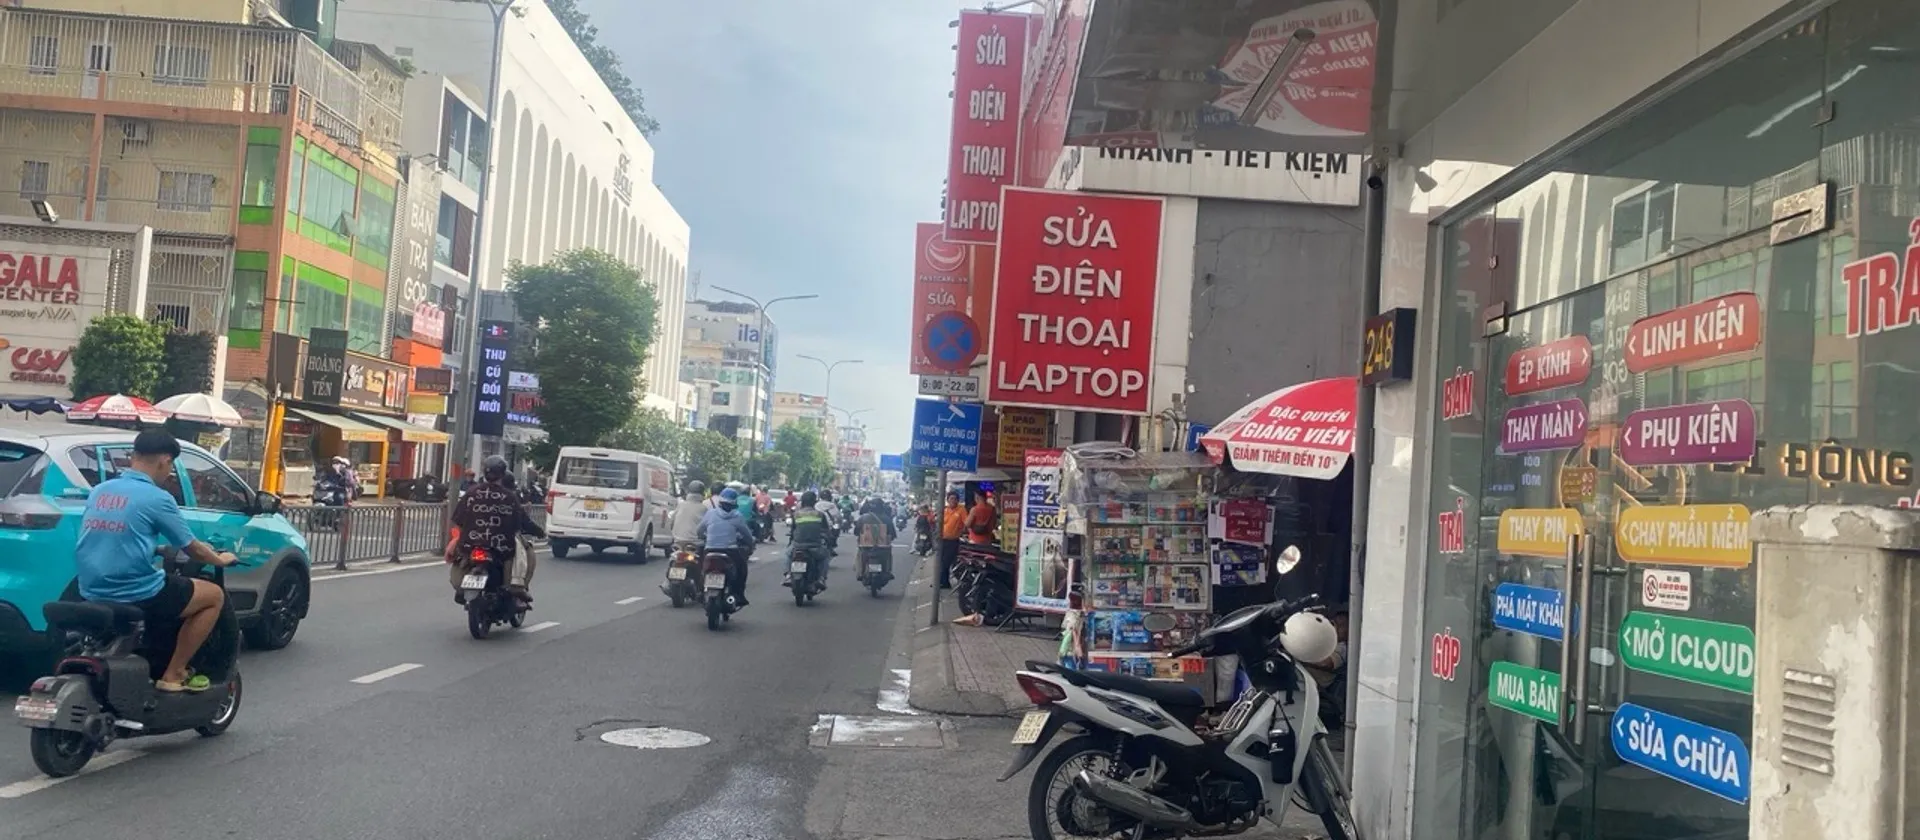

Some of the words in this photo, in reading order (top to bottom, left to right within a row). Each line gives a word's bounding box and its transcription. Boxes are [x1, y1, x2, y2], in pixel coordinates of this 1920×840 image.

[976, 24, 1007, 66] SỬA
[969, 84, 1006, 127] ĐIỆN
[962, 145, 1006, 183] THOẠI
[409, 201, 434, 237] BÁN
[950, 199, 999, 231] LAPTO
[1042, 206, 1118, 249] SỬA
[0, 252, 80, 292] GALA
[409, 238, 430, 277] TRẢ
[1032, 259, 1122, 304] ĐIỆN
[738, 323, 760, 342] ila
[1017, 313, 1131, 356] THOẠI
[1642, 319, 1687, 357] LINH
[1694, 299, 1746, 350] KIỆN
[11, 346, 73, 373] CGV
[308, 350, 342, 377] HOÀNG
[484, 348, 507, 361] THU
[1364, 321, 1394, 375] 248
[1518, 355, 1535, 384] ÉP
[1537, 348, 1571, 381] KÍNH
[311, 375, 333, 397] YẾN
[482, 379, 501, 395] ĐỔI
[485, 364, 501, 378] CŨ
[922, 381, 943, 391] 6:00
[950, 382, 976, 393] 22:00
[997, 360, 1144, 398] LAPTOP
[479, 399, 501, 413] MỚI
[1442, 366, 1474, 421] BÁN
[1240, 420, 1303, 441] GIẢNG
[1303, 425, 1352, 446] VIÊN
[1507, 415, 1539, 443] THAY
[1541, 403, 1575, 440] MÀN
[1641, 416, 1681, 456] PHỤ
[1687, 403, 1738, 454] KIỆN
[1232, 444, 1260, 463] GIẢM
[1262, 445, 1291, 465] THÊM
[1293, 449, 1317, 468] ĐẾN
[1781, 436, 1915, 488] ĐỘNG
[1030, 469, 1055, 482] iPhon
[1438, 496, 1464, 553] TRẢ
[1508, 515, 1540, 542] THAY
[1543, 515, 1567, 542] PIN
[1628, 520, 1665, 556] CHẠY
[1496, 591, 1515, 619] PHÁ
[1517, 594, 1537, 628] MẬT
[1432, 626, 1460, 681] GÓP
[1632, 618, 1665, 661] MỞ
[1671, 631, 1753, 677] ICLOUD
[1497, 671, 1525, 705] MUA
[1529, 675, 1559, 714] BÁN
[1629, 712, 1667, 761] SỬA
[1672, 733, 1741, 789] CHỮA
